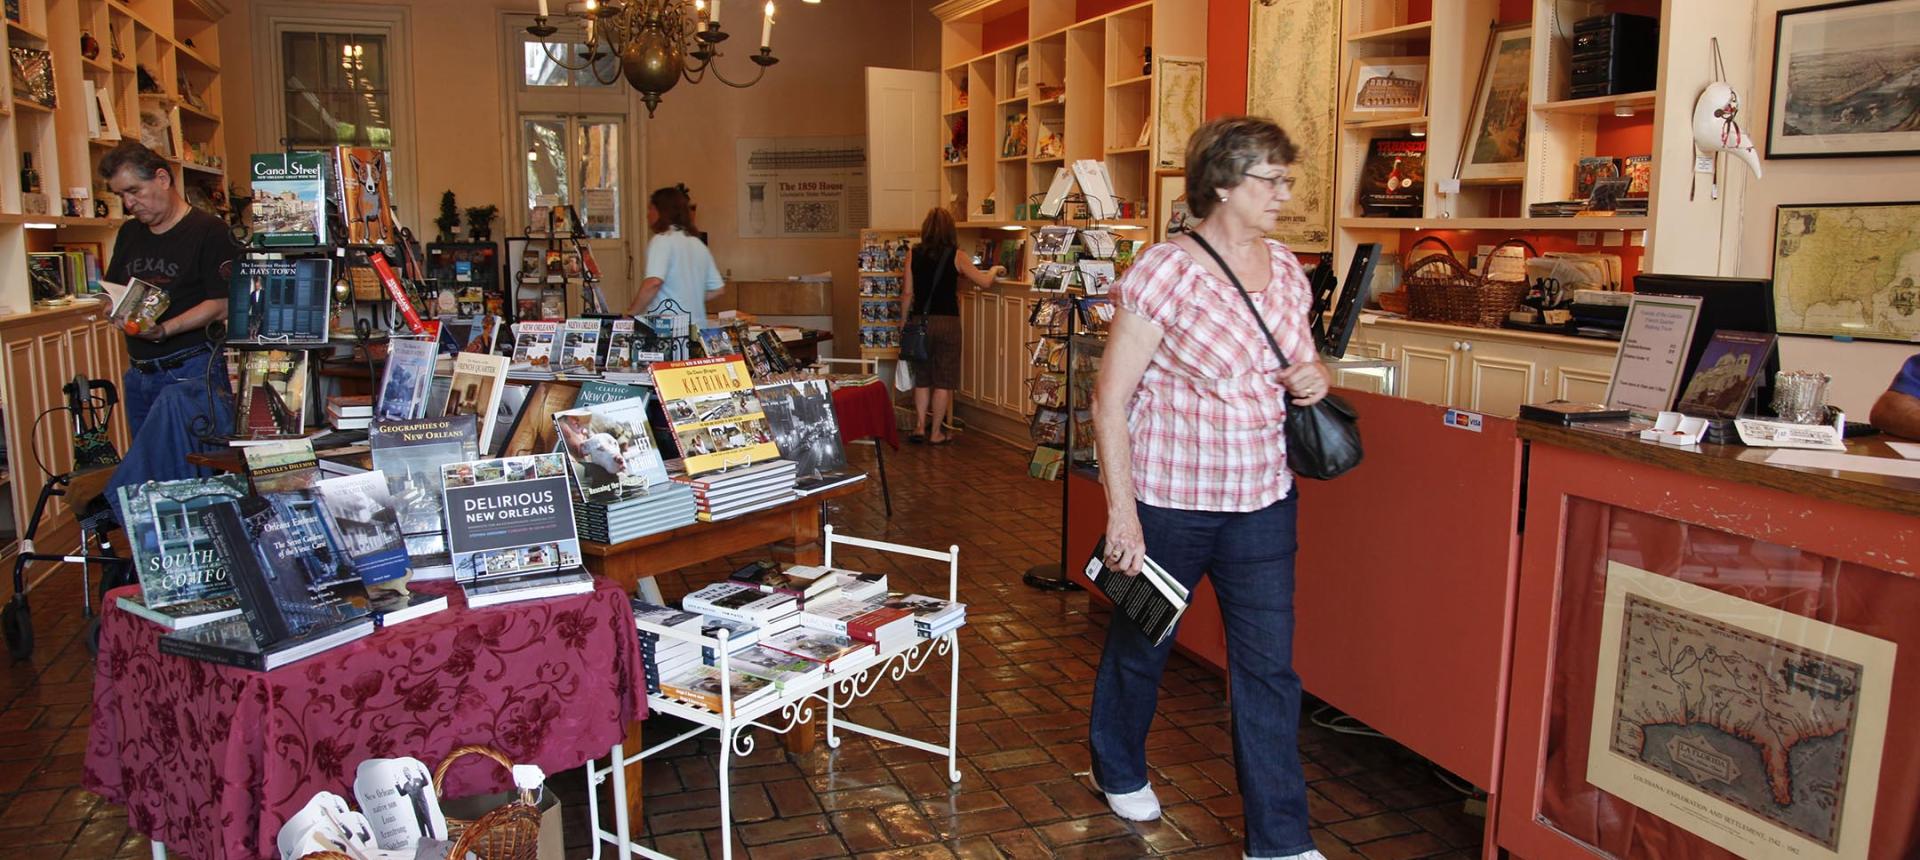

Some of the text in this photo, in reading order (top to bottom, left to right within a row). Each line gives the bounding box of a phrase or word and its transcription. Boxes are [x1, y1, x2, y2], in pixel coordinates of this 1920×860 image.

[254, 153, 320, 175] Canal Street
[779, 183, 795, 191] The
[798, 182, 817, 191] 1850
[126, 258, 179, 277] TEXAS
[682, 374, 730, 393] KATRINA
[581, 390, 602, 401] NEW
[380, 423, 438, 433] GEOGRAPHIES
[404, 430, 464, 441] NEW ORLEANS
[464, 490, 553, 511] DELIRIOUS
[466, 512, 495, 523] NEW
[498, 504, 555, 519] ORLEANS
[150, 550, 220, 571] SOUTH
[694, 589, 718, 598] CITY
[381, 815, 396, 824] Louis
[1709, 808, 1723, 820] AND
